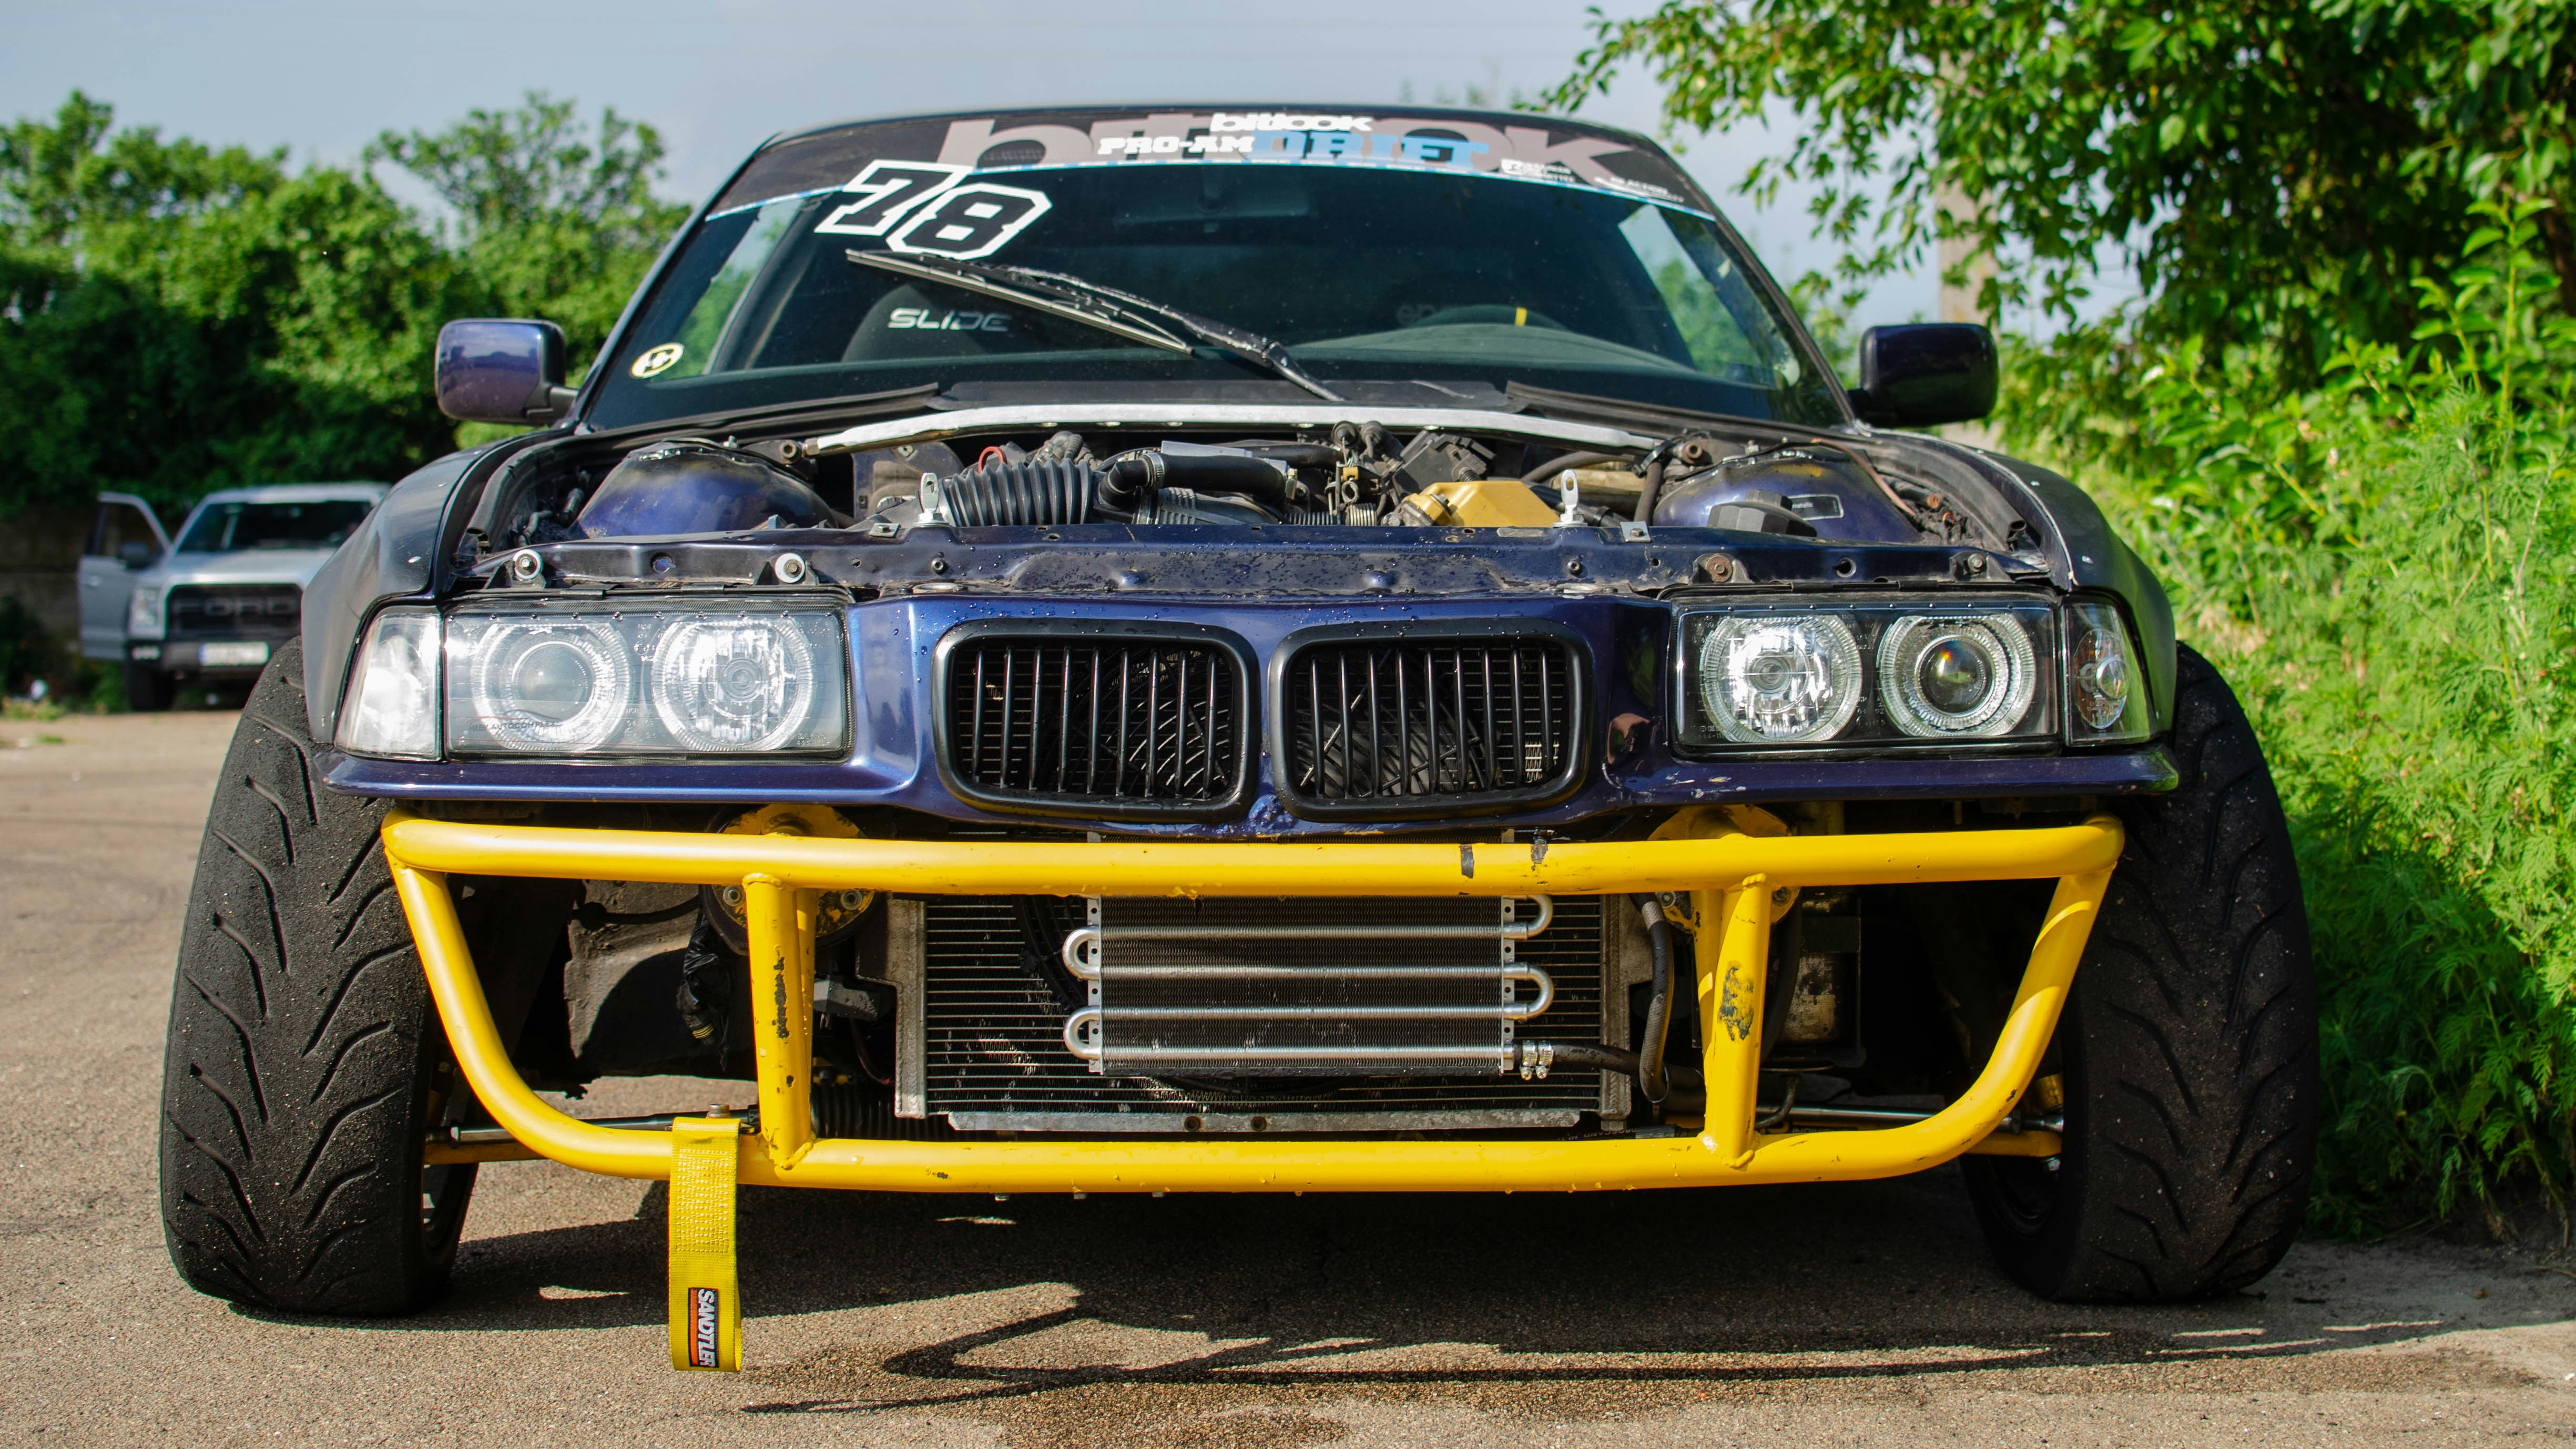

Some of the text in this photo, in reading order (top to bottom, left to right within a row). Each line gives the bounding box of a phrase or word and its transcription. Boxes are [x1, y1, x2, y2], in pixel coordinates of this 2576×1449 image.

[1098, 135, 1256, 155] PRO-AM
[1247, 129, 1489, 168] DRIFT
[814, 159, 1053, 260] 78
[887, 307, 1012, 332] SLIDE
[170, 597, 298, 616] FORD
[698, 1288, 716, 1367] SANDTLER
